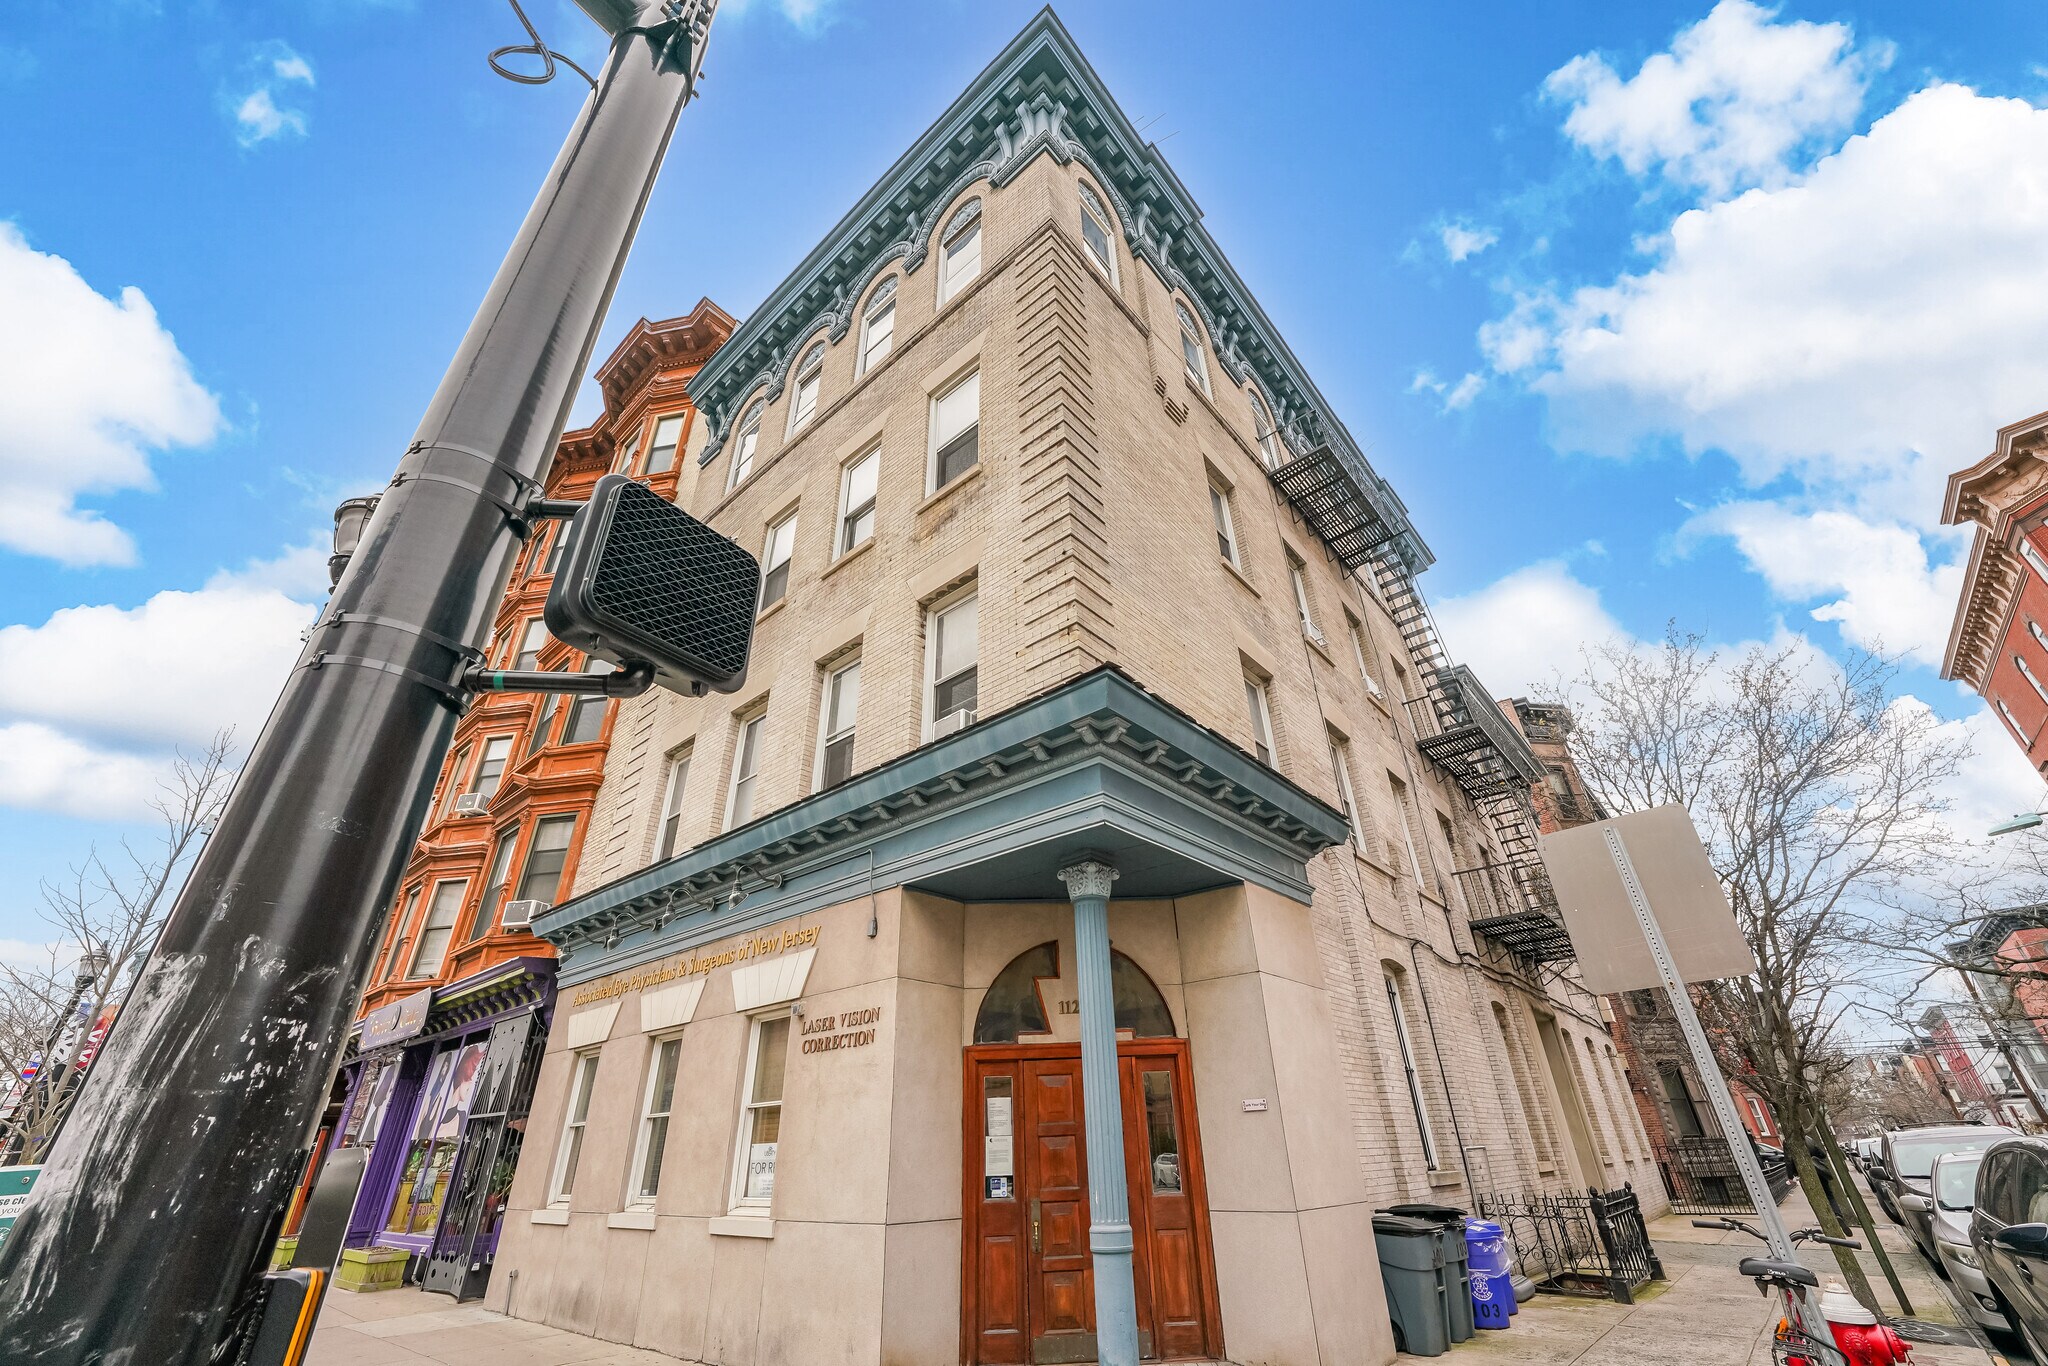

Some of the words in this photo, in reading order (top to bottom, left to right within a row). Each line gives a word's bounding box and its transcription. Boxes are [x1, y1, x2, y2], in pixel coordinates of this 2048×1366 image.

[572, 981, 612, 1007] Associated
[614, 979, 629, 998] Eye
[630, 966, 677, 992] Physicians
[677, 961, 687, 977] &
[689, 948, 736, 975] Surgeons
[738, 939, 752, 961] of
[751, 936, 779, 959] New
[780, 925, 821, 954] Jersey
[801, 1016, 836, 1036] LASER
[840, 1006, 881, 1028] VISION
[801, 1028, 876, 1055] CORRECTION
[751, 1162, 766, 1174] FOR
